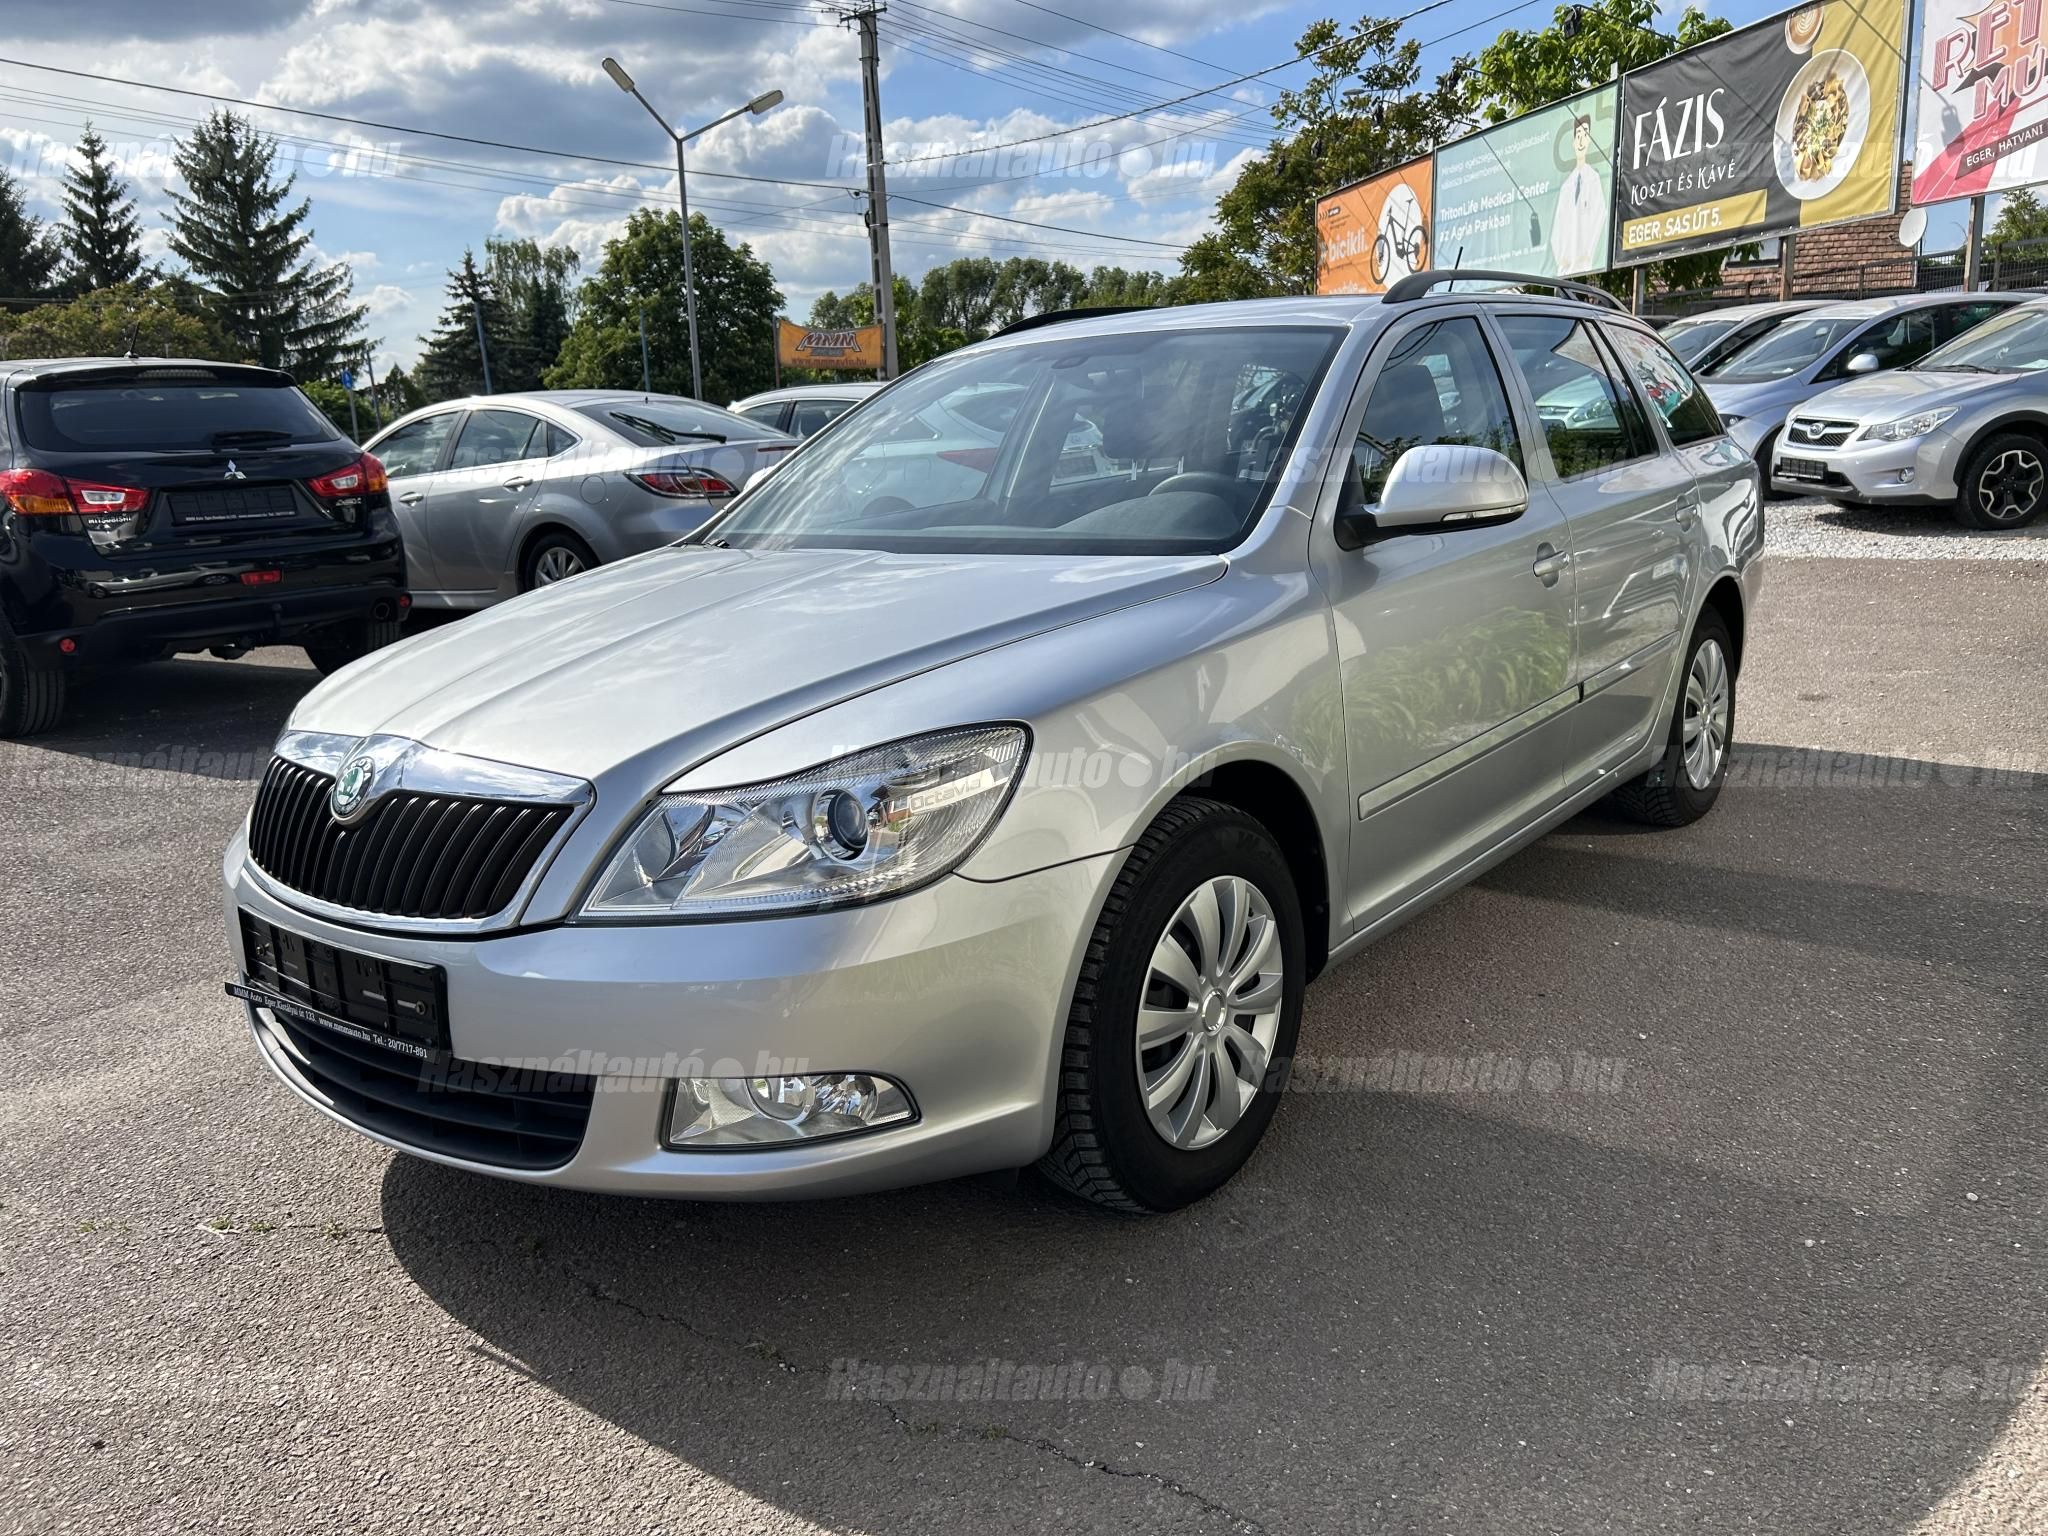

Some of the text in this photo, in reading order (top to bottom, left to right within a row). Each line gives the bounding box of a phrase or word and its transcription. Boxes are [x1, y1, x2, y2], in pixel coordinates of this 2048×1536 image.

[1633, 88, 1725, 170] FÁZIS
[1966, 124, 2044, 168] EGER, HATVANI
[1480, 187, 1515, 212] Medical
[1518, 180, 1550, 201] Center
[1631, 158, 1736, 206] KOSZT ÉS KÁVÉ
[1450, 222, 1473, 241] Agria
[1474, 214, 1511, 234] Parkban
[1628, 207, 1722, 245] EGER, SAS ÚT 5.
[796, 331, 862, 352] MMM
[372, 1033, 387, 1047] Tel.:
[387, 1038, 428, 1058] 20/7717-891
